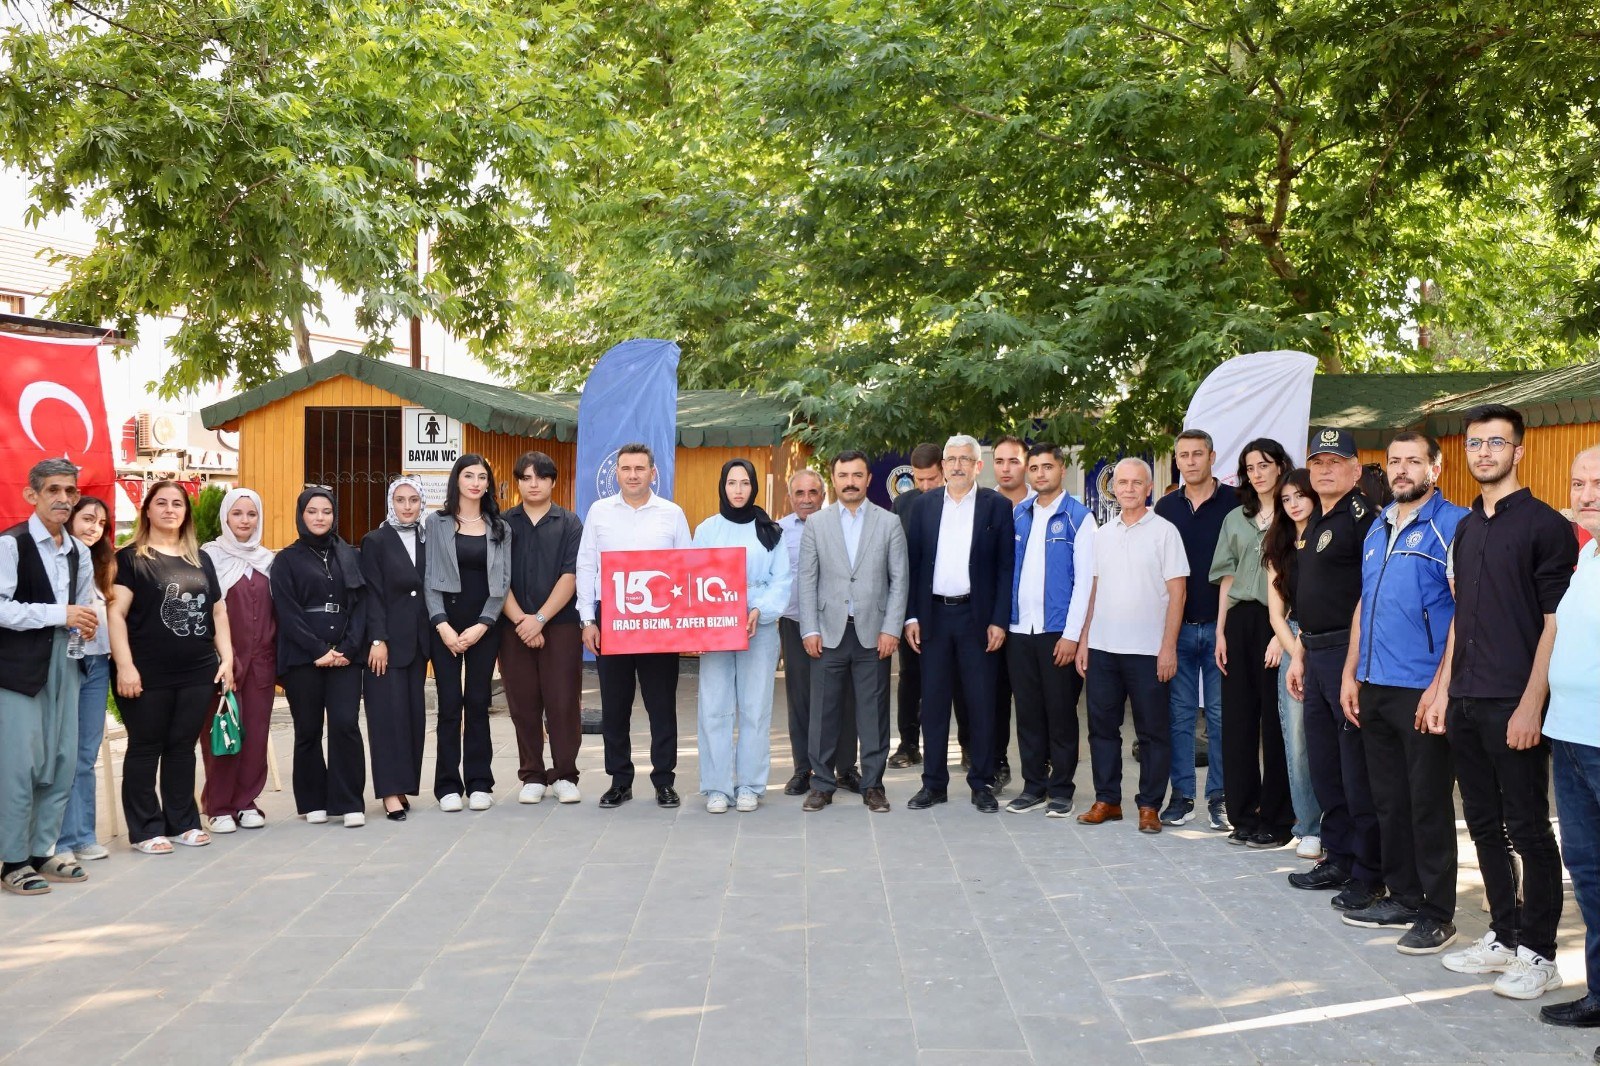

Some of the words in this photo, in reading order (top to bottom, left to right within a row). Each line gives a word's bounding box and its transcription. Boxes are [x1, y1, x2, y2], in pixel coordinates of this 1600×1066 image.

[408, 450, 438, 461] BAYAN
[441, 450, 457, 461] WC
[676, 617, 705, 628] ZAFER
